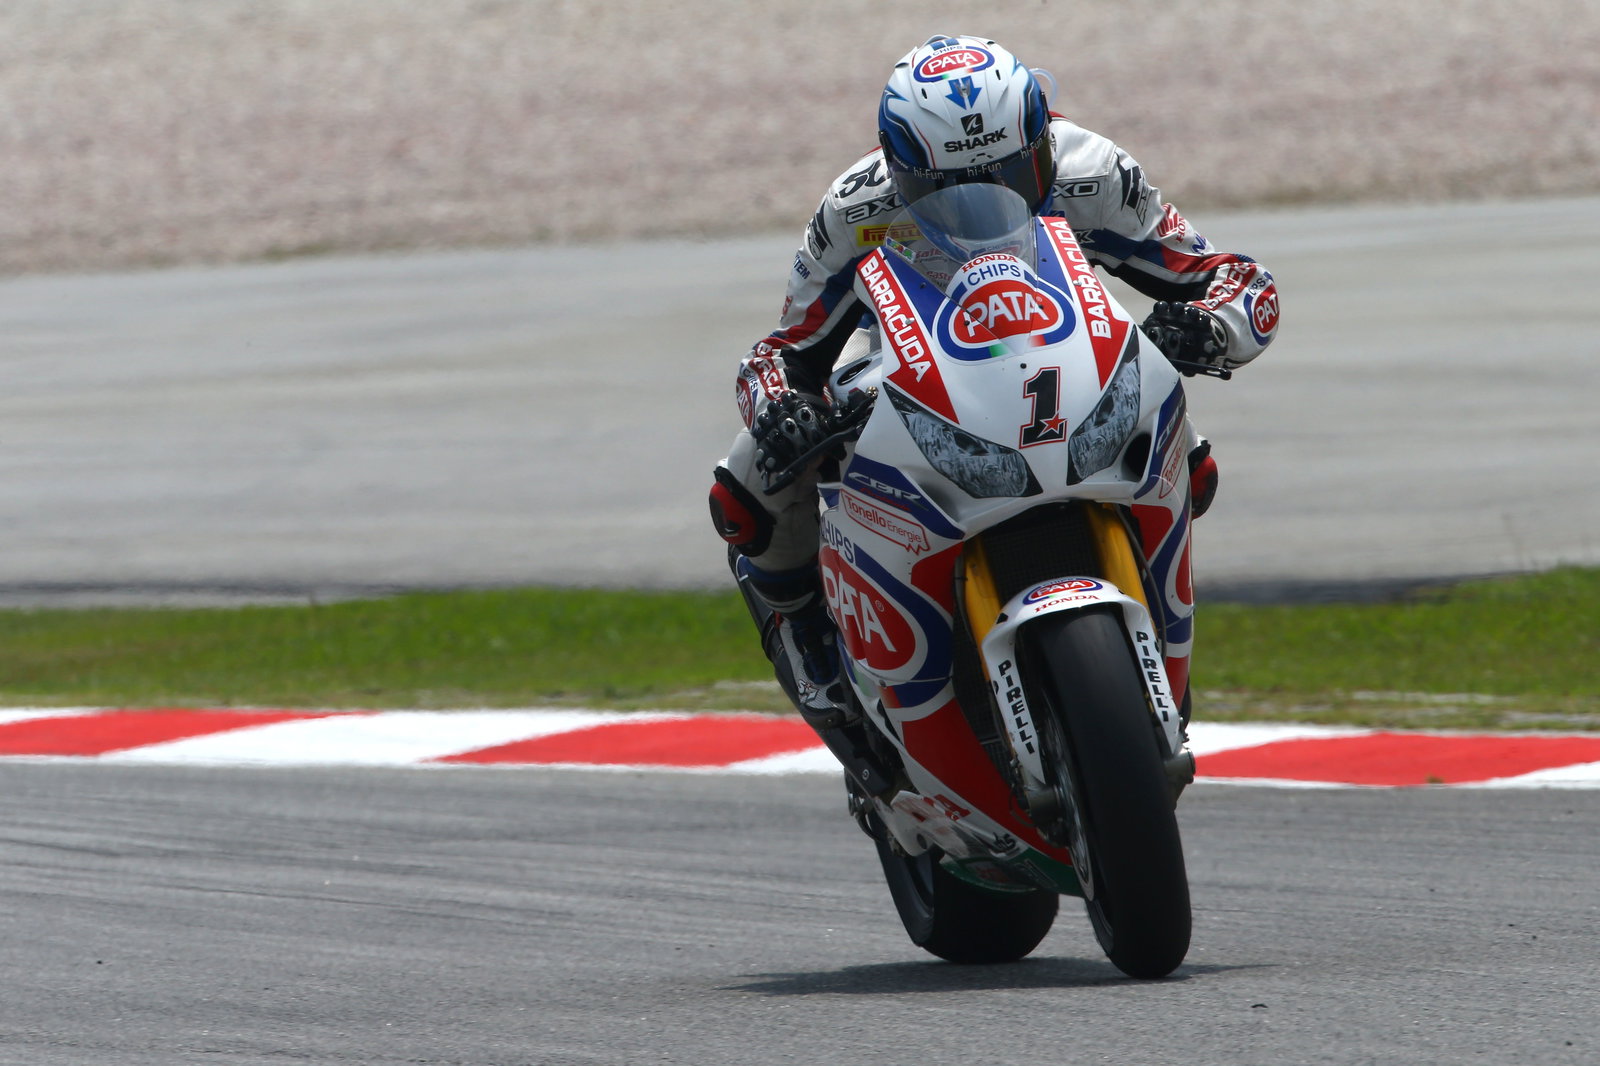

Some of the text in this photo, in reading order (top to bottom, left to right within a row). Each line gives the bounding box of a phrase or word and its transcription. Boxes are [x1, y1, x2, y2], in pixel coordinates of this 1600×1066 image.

[927, 52, 978, 73] PATA
[932, 45, 963, 57] CHIPS
[944, 127, 1008, 153] SHARK
[913, 167, 945, 180] hi-Fun
[967, 162, 1003, 178] hi-Fun
[961, 253, 1018, 273] HONDA
[967, 263, 1021, 286] CHIPS
[1050, 220, 1112, 339] BARRACUDA
[860, 256, 932, 383] BARRACUDA
[963, 291, 1050, 337] PATA
[1019, 366, 1068, 449] 1
[848, 472, 922, 506] CBR
[845, 495, 887, 527] Tonello
[886, 520, 922, 543] Energie
[1034, 594, 1101, 613] HONDA
[1036, 580, 1088, 597] PATA
[822, 565, 897, 652] PATA
[1136, 631, 1169, 722] PIRELLI
[998, 659, 1035, 755] PIRELLI
